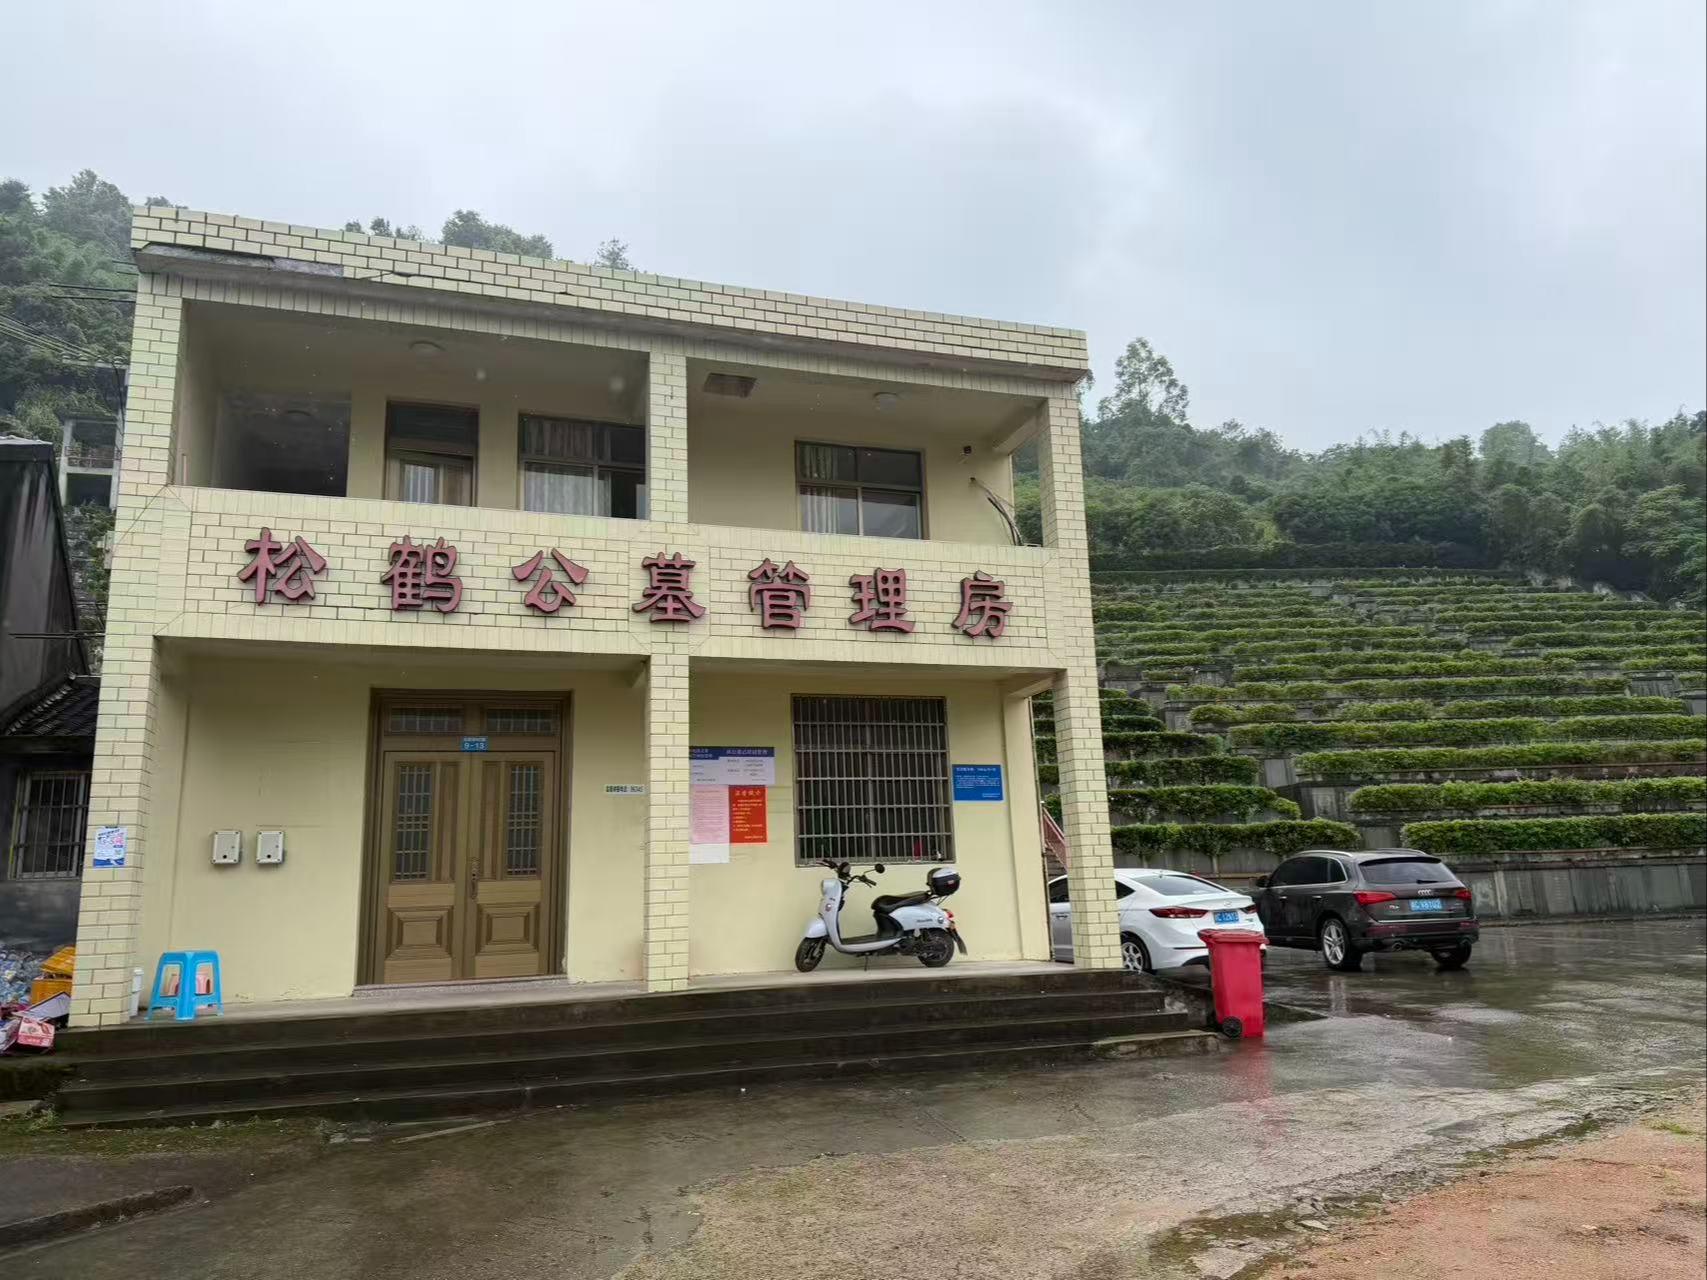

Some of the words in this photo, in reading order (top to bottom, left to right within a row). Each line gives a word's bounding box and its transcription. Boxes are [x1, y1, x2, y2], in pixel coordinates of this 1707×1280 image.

[237, 527, 1013, 639] 松鹤公墓管理房
